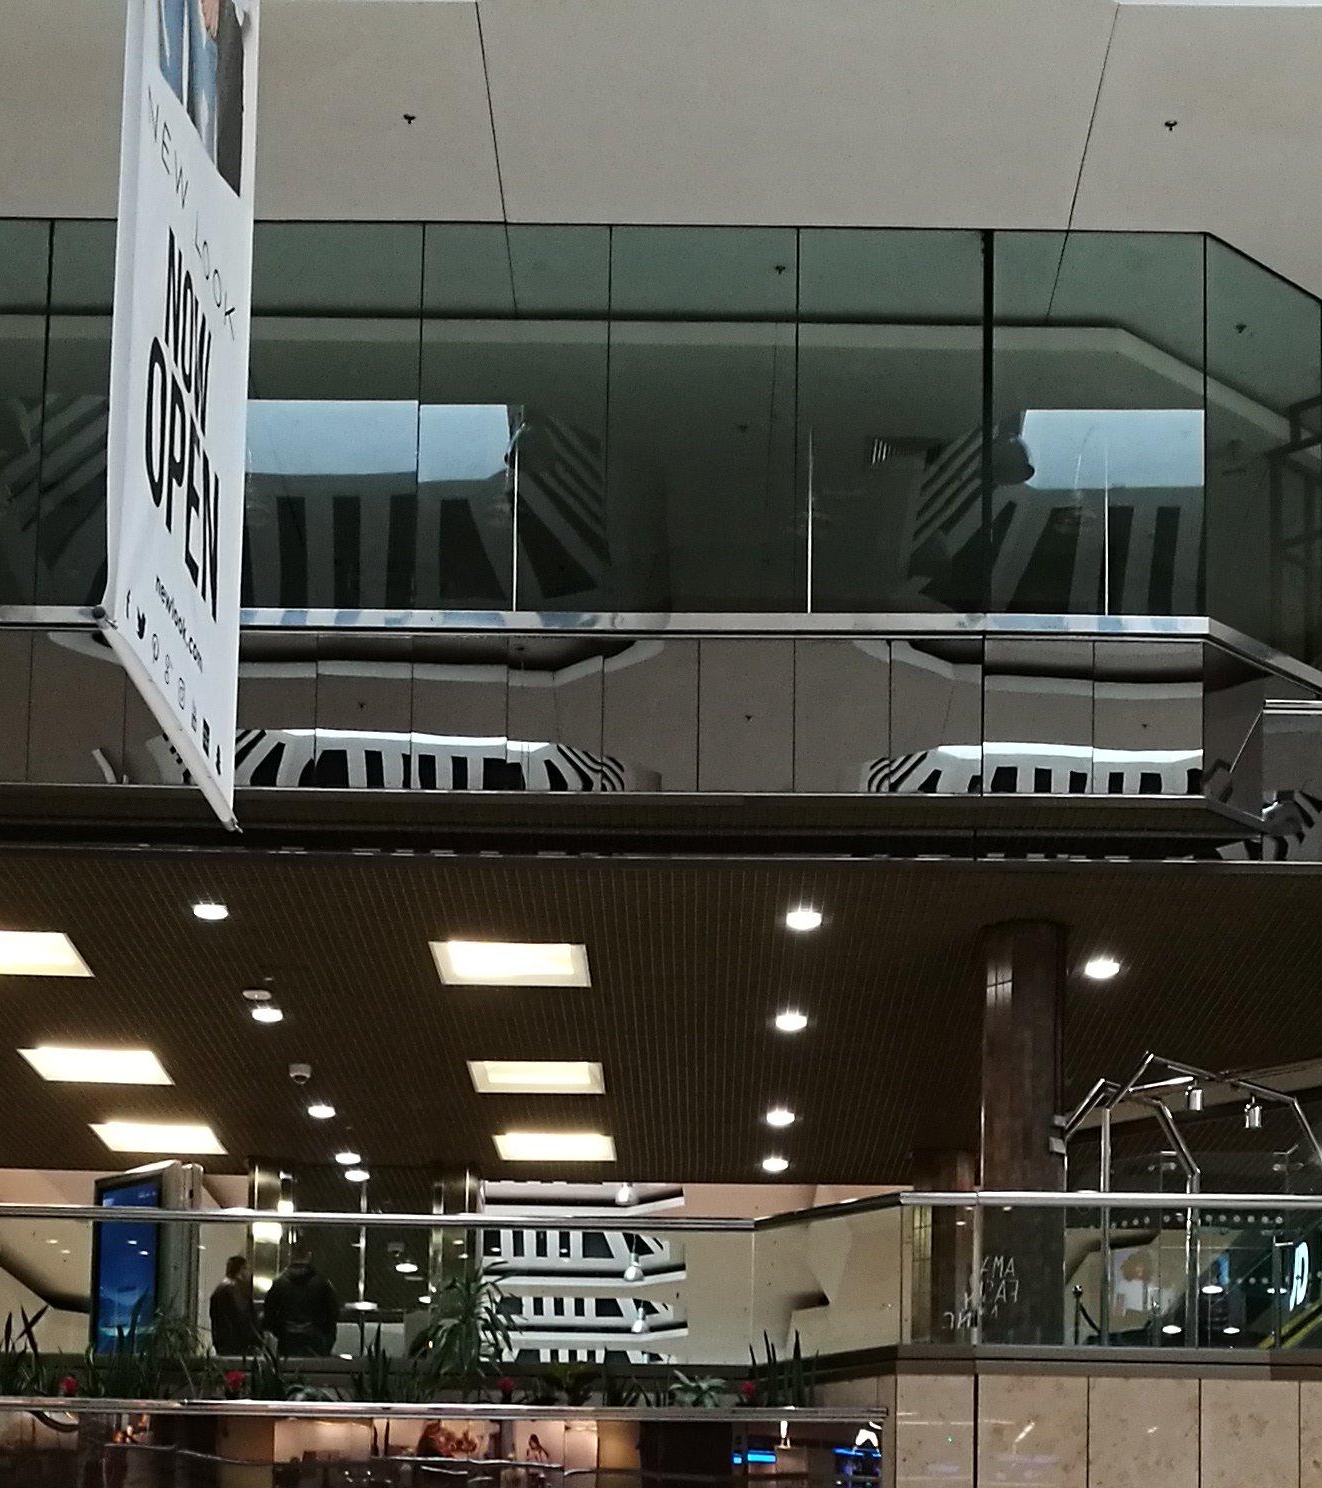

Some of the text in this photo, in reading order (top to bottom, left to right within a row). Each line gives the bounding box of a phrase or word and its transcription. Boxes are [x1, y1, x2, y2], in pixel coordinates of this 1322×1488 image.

[148, 84, 235, 341] NEW LOOK
[165, 225, 211, 438] NOW
[145, 336, 219, 624] OPEN
